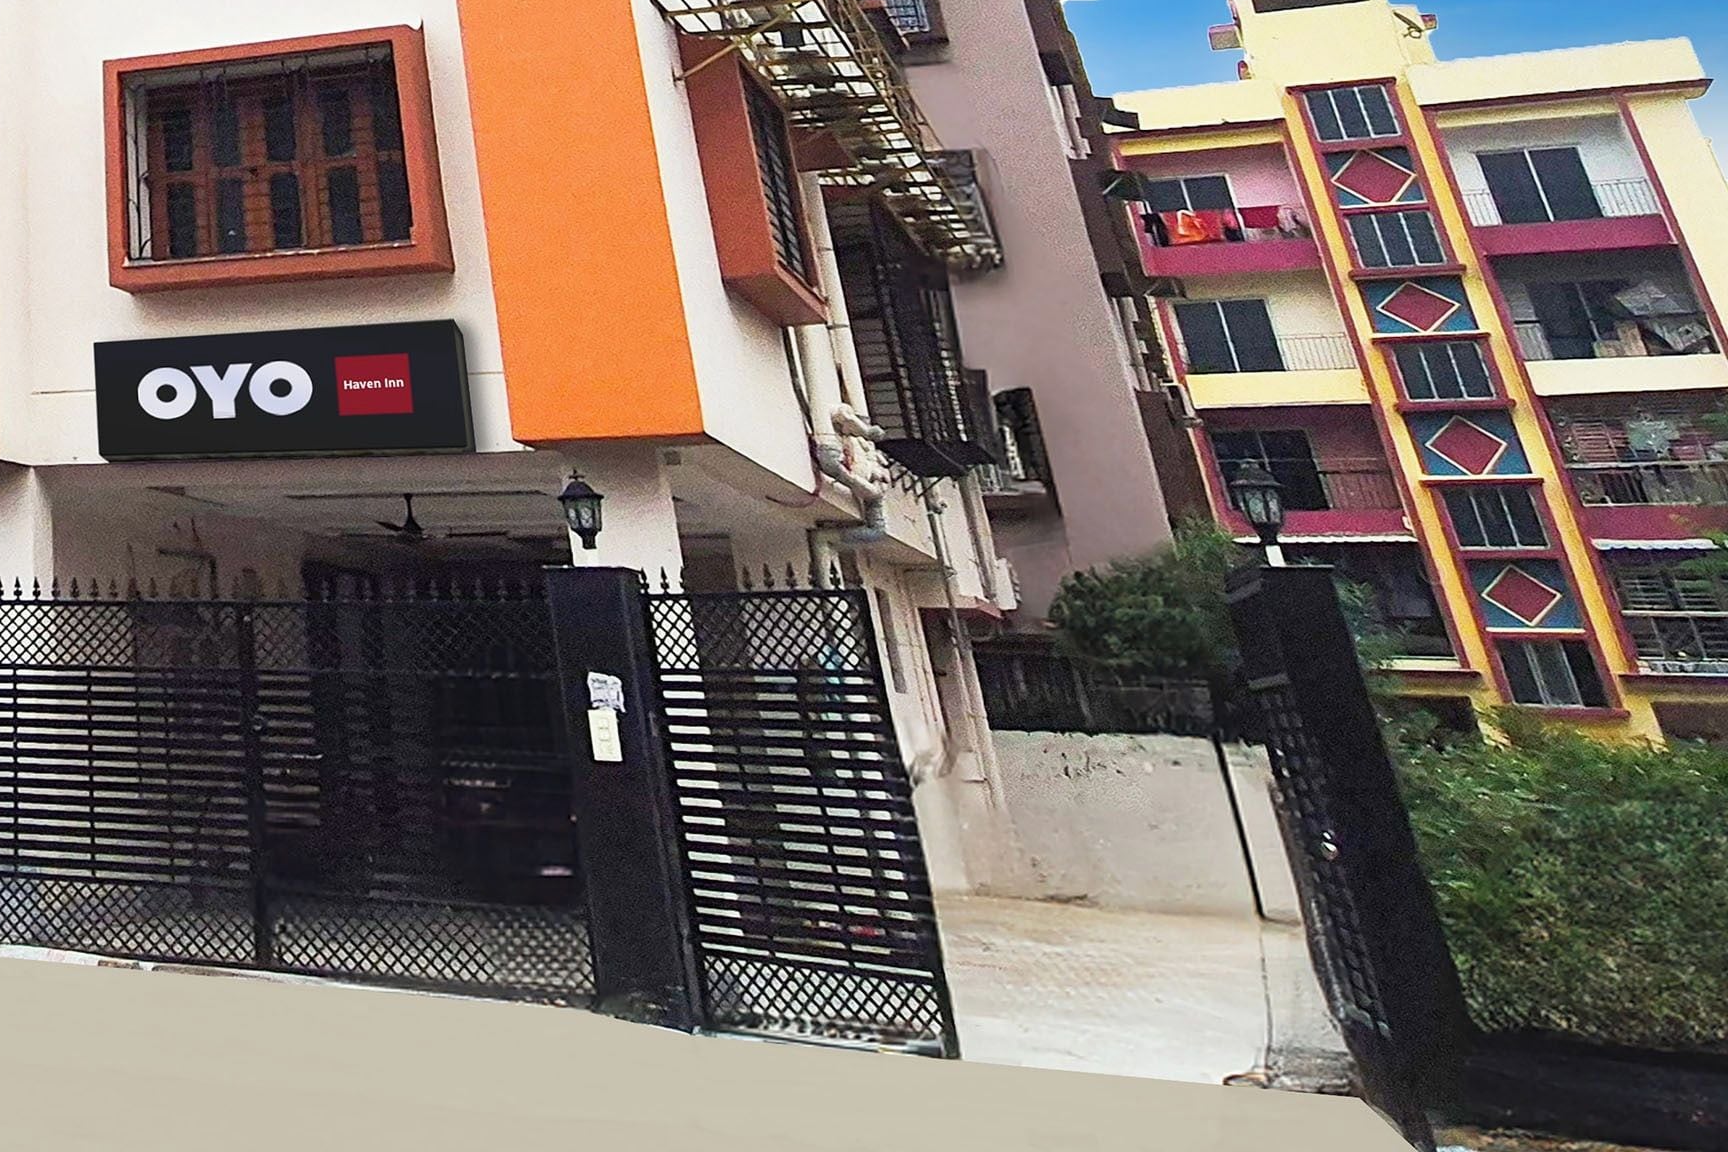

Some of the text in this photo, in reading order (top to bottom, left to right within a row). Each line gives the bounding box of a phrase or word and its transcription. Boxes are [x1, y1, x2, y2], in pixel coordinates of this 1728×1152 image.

[137, 360, 314, 420] OYO
[343, 377, 405, 390] Haven Inn
